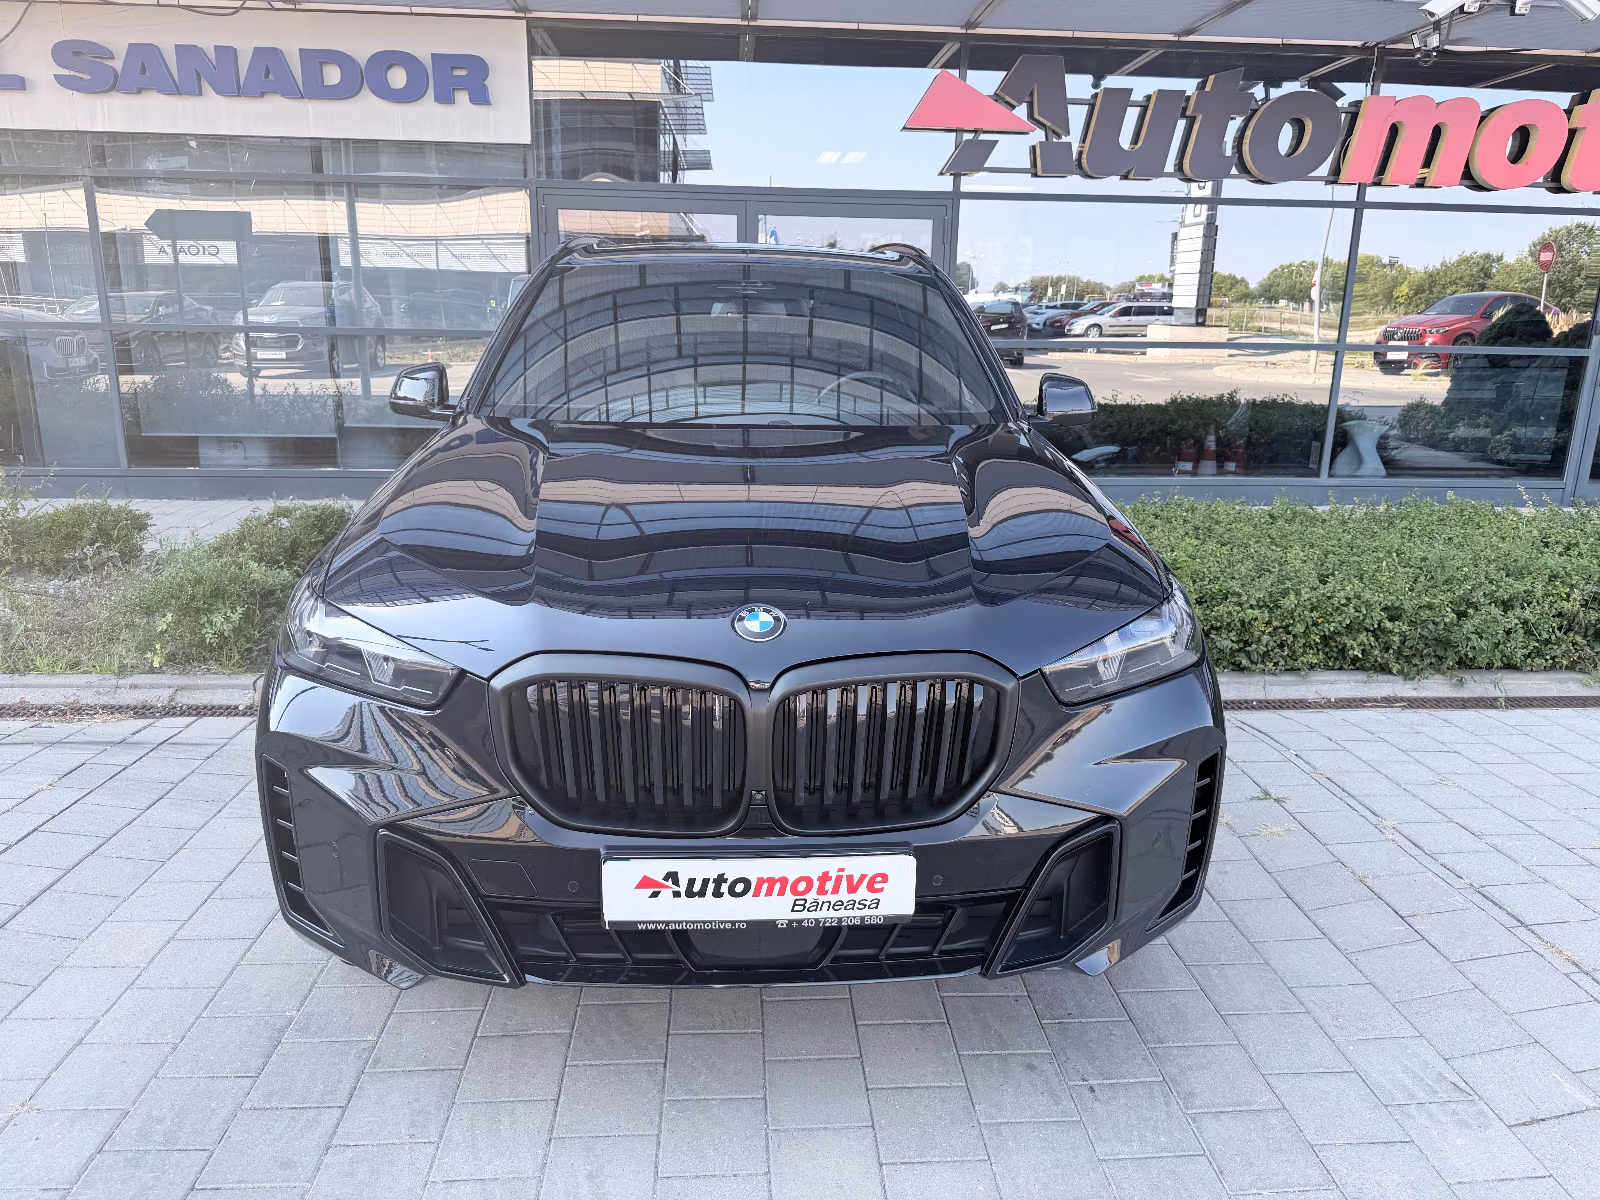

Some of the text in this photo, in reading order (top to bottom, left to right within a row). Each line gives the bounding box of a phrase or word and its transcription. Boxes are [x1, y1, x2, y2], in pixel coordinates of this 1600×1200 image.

[50, 39, 492, 106] SANADOR
[634, 868, 889, 898] Automotive
[790, 898, 881, 913] Băneasa
[637, 921, 747, 930] www.automotive.ro
[801, 918, 816, 927] 40
[819, 917, 838, 927] 722
[841, 916, 861, 926] 206
[864, 915, 884, 925] 580
